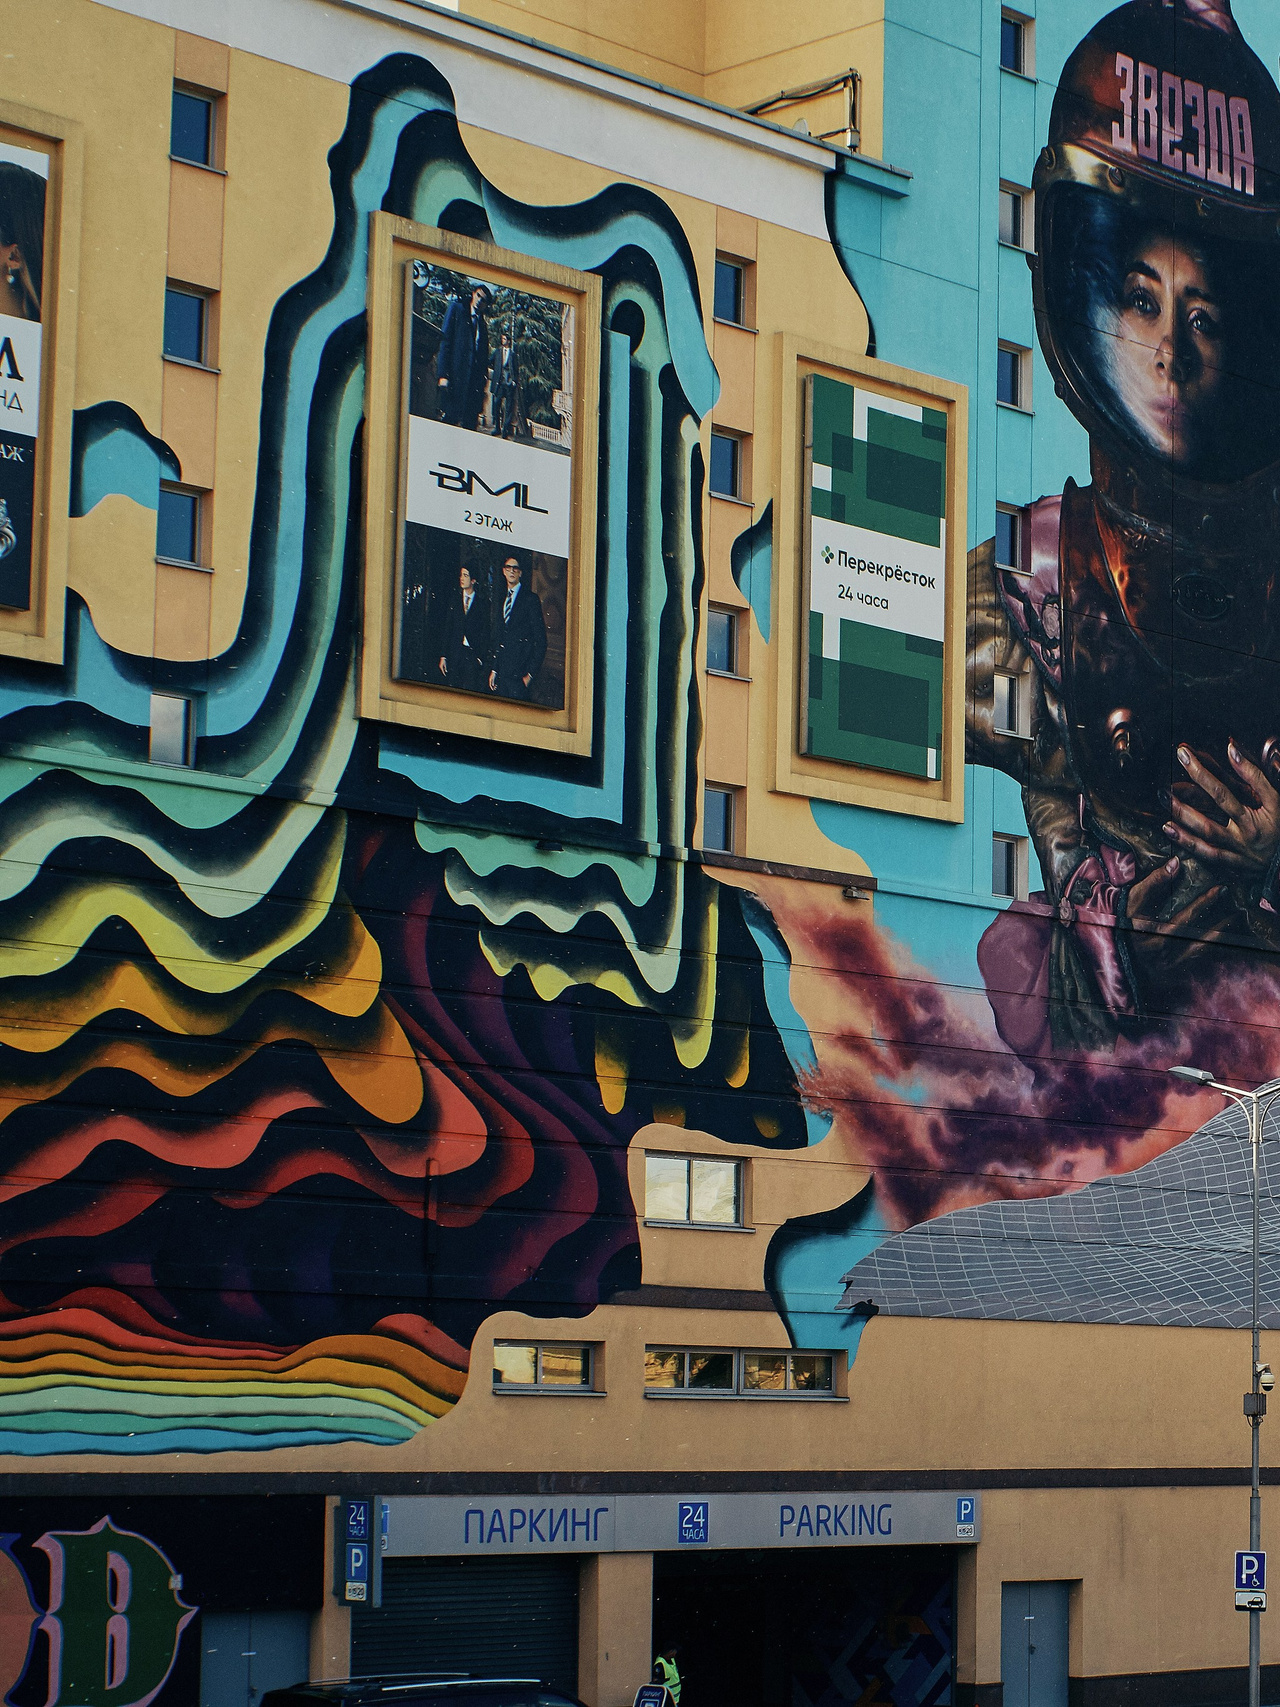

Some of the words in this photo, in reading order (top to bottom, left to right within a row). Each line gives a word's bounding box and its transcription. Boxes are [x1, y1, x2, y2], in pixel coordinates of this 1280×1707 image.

[428, 461, 549, 515] BML
[463, 510, 473, 523] 2
[474, 512, 514, 533] ЭТАЖ
[837, 549, 936, 590] Перекрёсток
[837, 583, 854, 602] 24
[856, 591, 889, 609] часа
[349, 1505, 365, 1525] 24
[682, 1505, 705, 1528] 24
[779, 1503, 893, 1537] PARKING
[961, 1500, 971, 1521] P
[464, 1507, 609, 1544] ПАРКИНГ
[682, 1529, 705, 1540] ЧАСА
[351, 1548, 363, 1577] P
[1242, 1555, 1259, 1584] P
